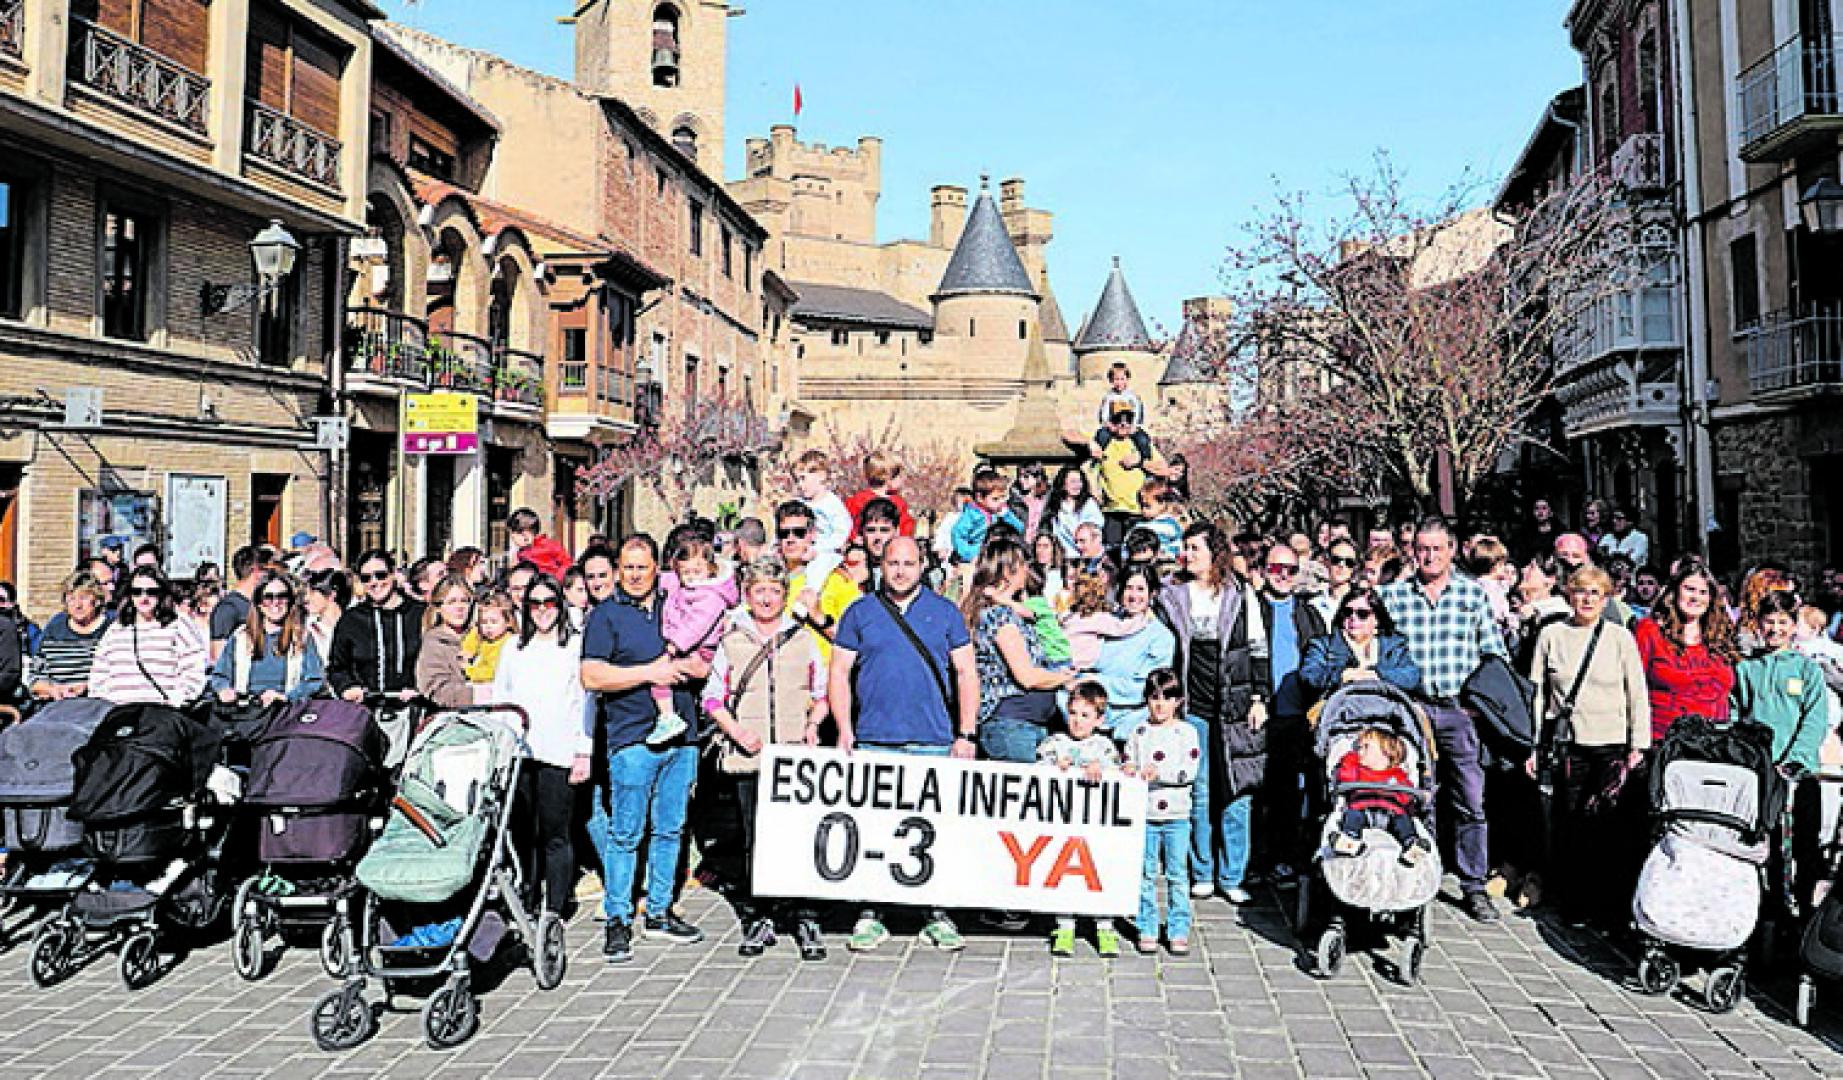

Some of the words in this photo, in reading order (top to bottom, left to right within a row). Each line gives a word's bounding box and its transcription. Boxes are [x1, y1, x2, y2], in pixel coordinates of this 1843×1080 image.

[771, 757, 942, 812] ESCUELA
[958, 770, 1132, 827] INFANTIL
[814, 812, 936, 887] 0-3
[998, 831, 1103, 892] YA
